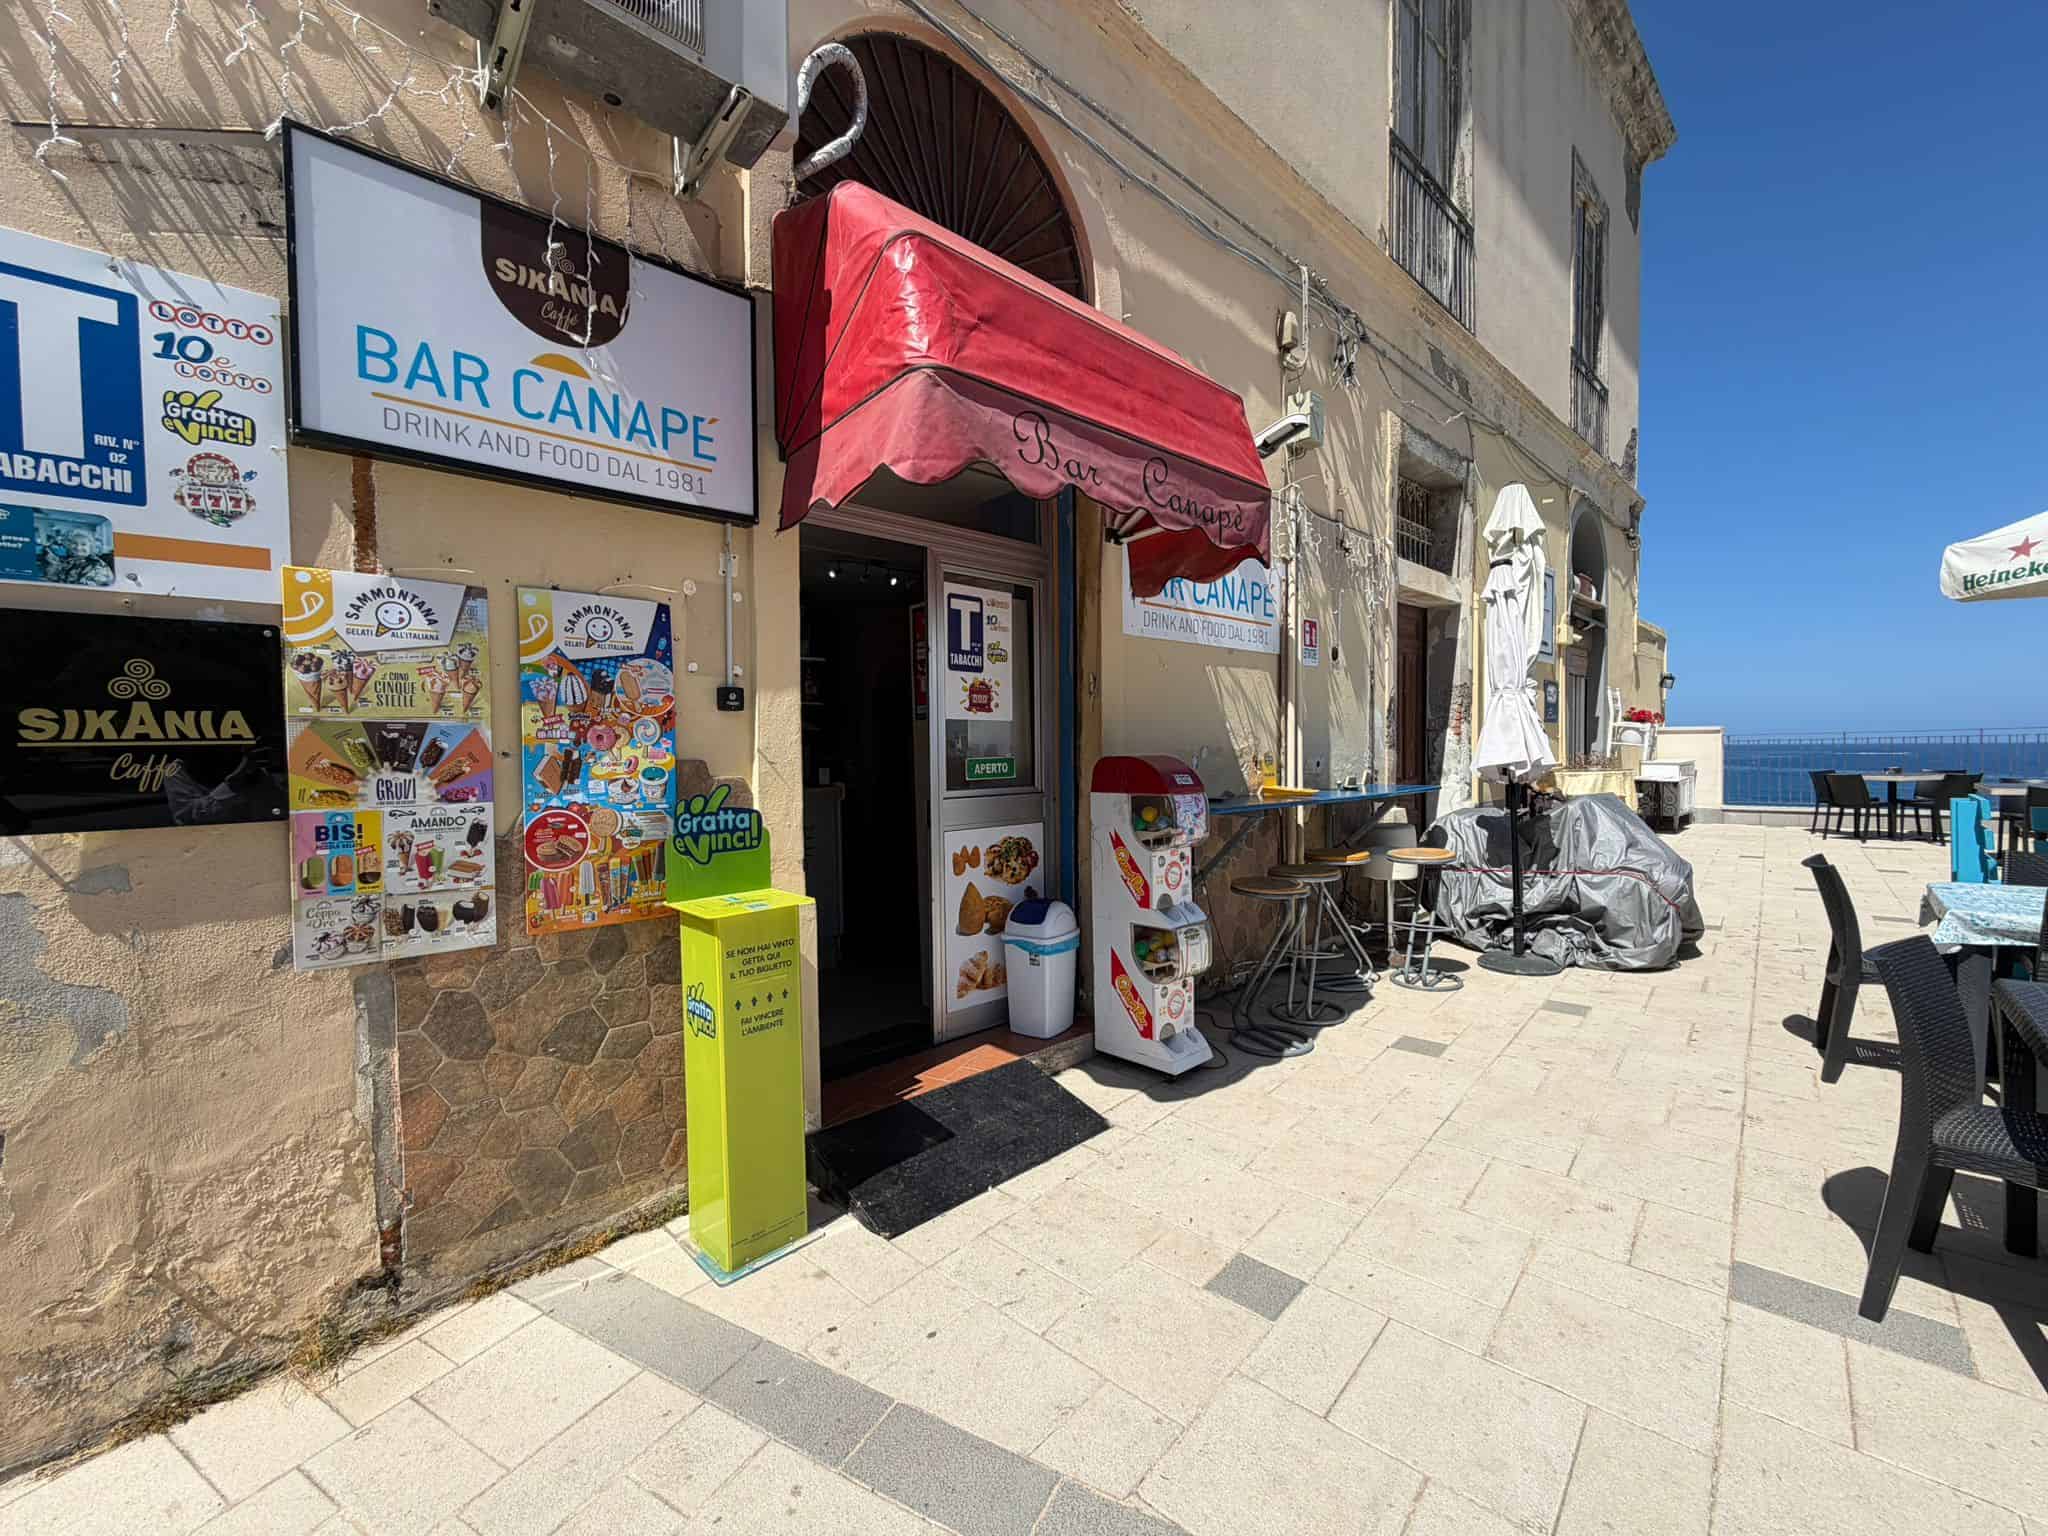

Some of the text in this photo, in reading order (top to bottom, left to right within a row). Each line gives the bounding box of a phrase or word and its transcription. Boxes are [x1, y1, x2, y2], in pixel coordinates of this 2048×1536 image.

[495, 257, 619, 318] SIKANIA
[148, 300, 275, 346] LOTTO
[152, 331, 214, 364] 10
[174, 361, 272, 394] LOTTO
[356, 324, 491, 409] BAR
[166, 401, 244, 430] Gratta
[93, 433, 120, 448] RIV.
[383, 407, 708, 495] DRINK AND FOOD DAL 1981
[1013, 410, 1104, 487] Bar
[108, 451, 129, 465] 02
[345, 587, 439, 626] SAMMONTANA
[345, 627, 374, 637] GELATI
[564, 604, 634, 639] SAMMONTANA
[1143, 610, 1270, 646] DRINK AND FOOD DAL 1981
[950, 652, 982, 667] TABACCHI
[374, 680, 416, 697] CINQUE
[376, 693, 416, 708] STELLE
[17, 701, 256, 741] SIKANIA
[974, 762, 1009, 775] APERTO
[376, 777, 417, 801] GRUVI
[314, 823, 363, 842] BIS!
[410, 815, 466, 829] AMANDO
[678, 809, 750, 834] Gratta
[683, 812, 760, 863] Vinci!
[726, 937, 794, 959] SE NON HAI VINTO
[742, 951, 781, 967] GETTA QUI
[738, 966, 756, 979] TUO
[756, 959, 793, 975] BIGLIETTO
